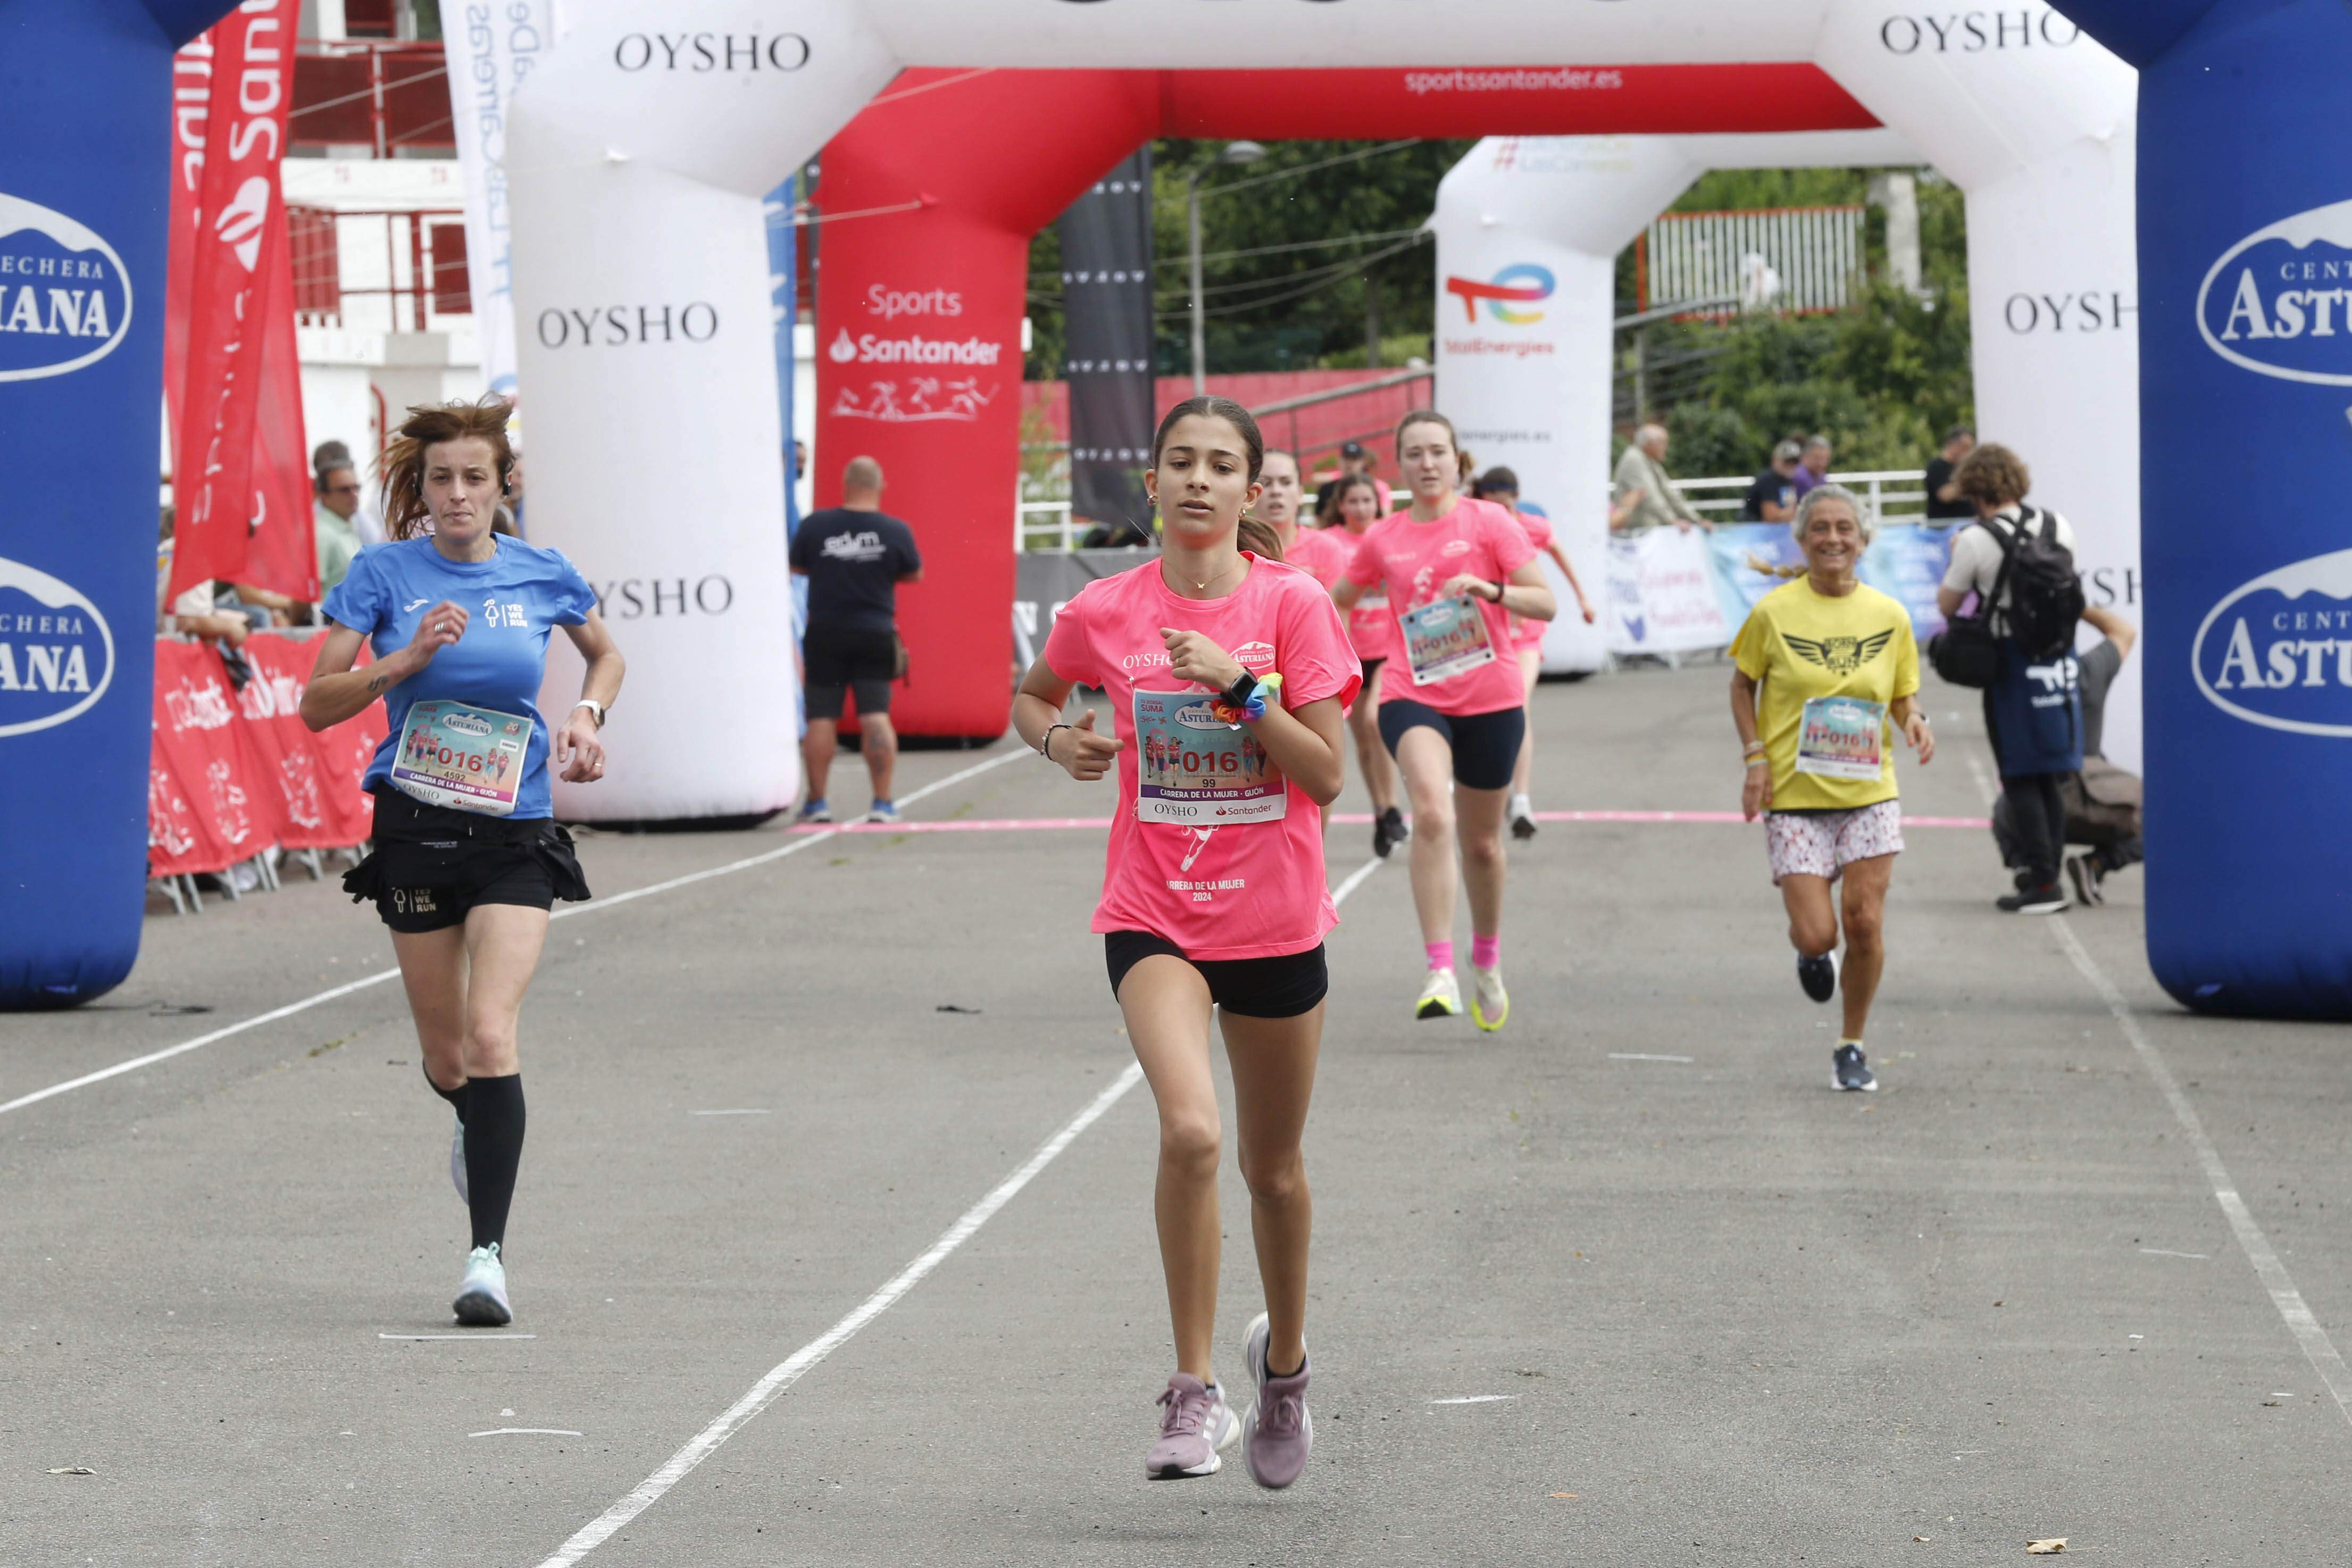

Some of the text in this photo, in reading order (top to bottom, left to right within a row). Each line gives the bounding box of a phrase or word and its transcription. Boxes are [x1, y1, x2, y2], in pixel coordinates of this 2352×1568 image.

[1881, 9, 2079, 55] OYSHO
[615, 32, 811, 72] OYSHO
[1405, 68, 1622, 96] sportssantander.es
[868, 283, 963, 321] Sports
[2005, 292, 2139, 335] OYSH
[538, 302, 718, 351] OYSHO
[858, 332, 1002, 365] Santander
[587, 574, 733, 620] YSHO
[510, 619, 528, 628] RUN
[1140, 704, 1164, 713] SUMA
[446, 716, 489, 735] ASTURIANA
[1830, 731, 1860, 747] 016
[438, 747, 483, 772] 016
[1182, 750, 1239, 773] 016
[410, 772, 436, 785] CARRERA
[446, 780, 454, 788] LA
[455, 782, 476, 793] MUJER
[444, 771, 465, 782] 4592
[1202, 779, 1216, 788] 99
[403, 783, 440, 800] OYSHO
[1160, 786, 1264, 798] CARRERA DE LA MUJER GIJÓN
[463, 799, 499, 813] Santander
[1154, 803, 1272, 818] OYSHO Santander
[1195, 881, 1205, 890] DE
[1207, 881, 1217, 890] LA
[1218, 879, 1245, 890] MUJER
[415, 895, 430, 904] WE
[1192, 891, 1212, 902] 2024
[416, 903, 437, 913] RUN
